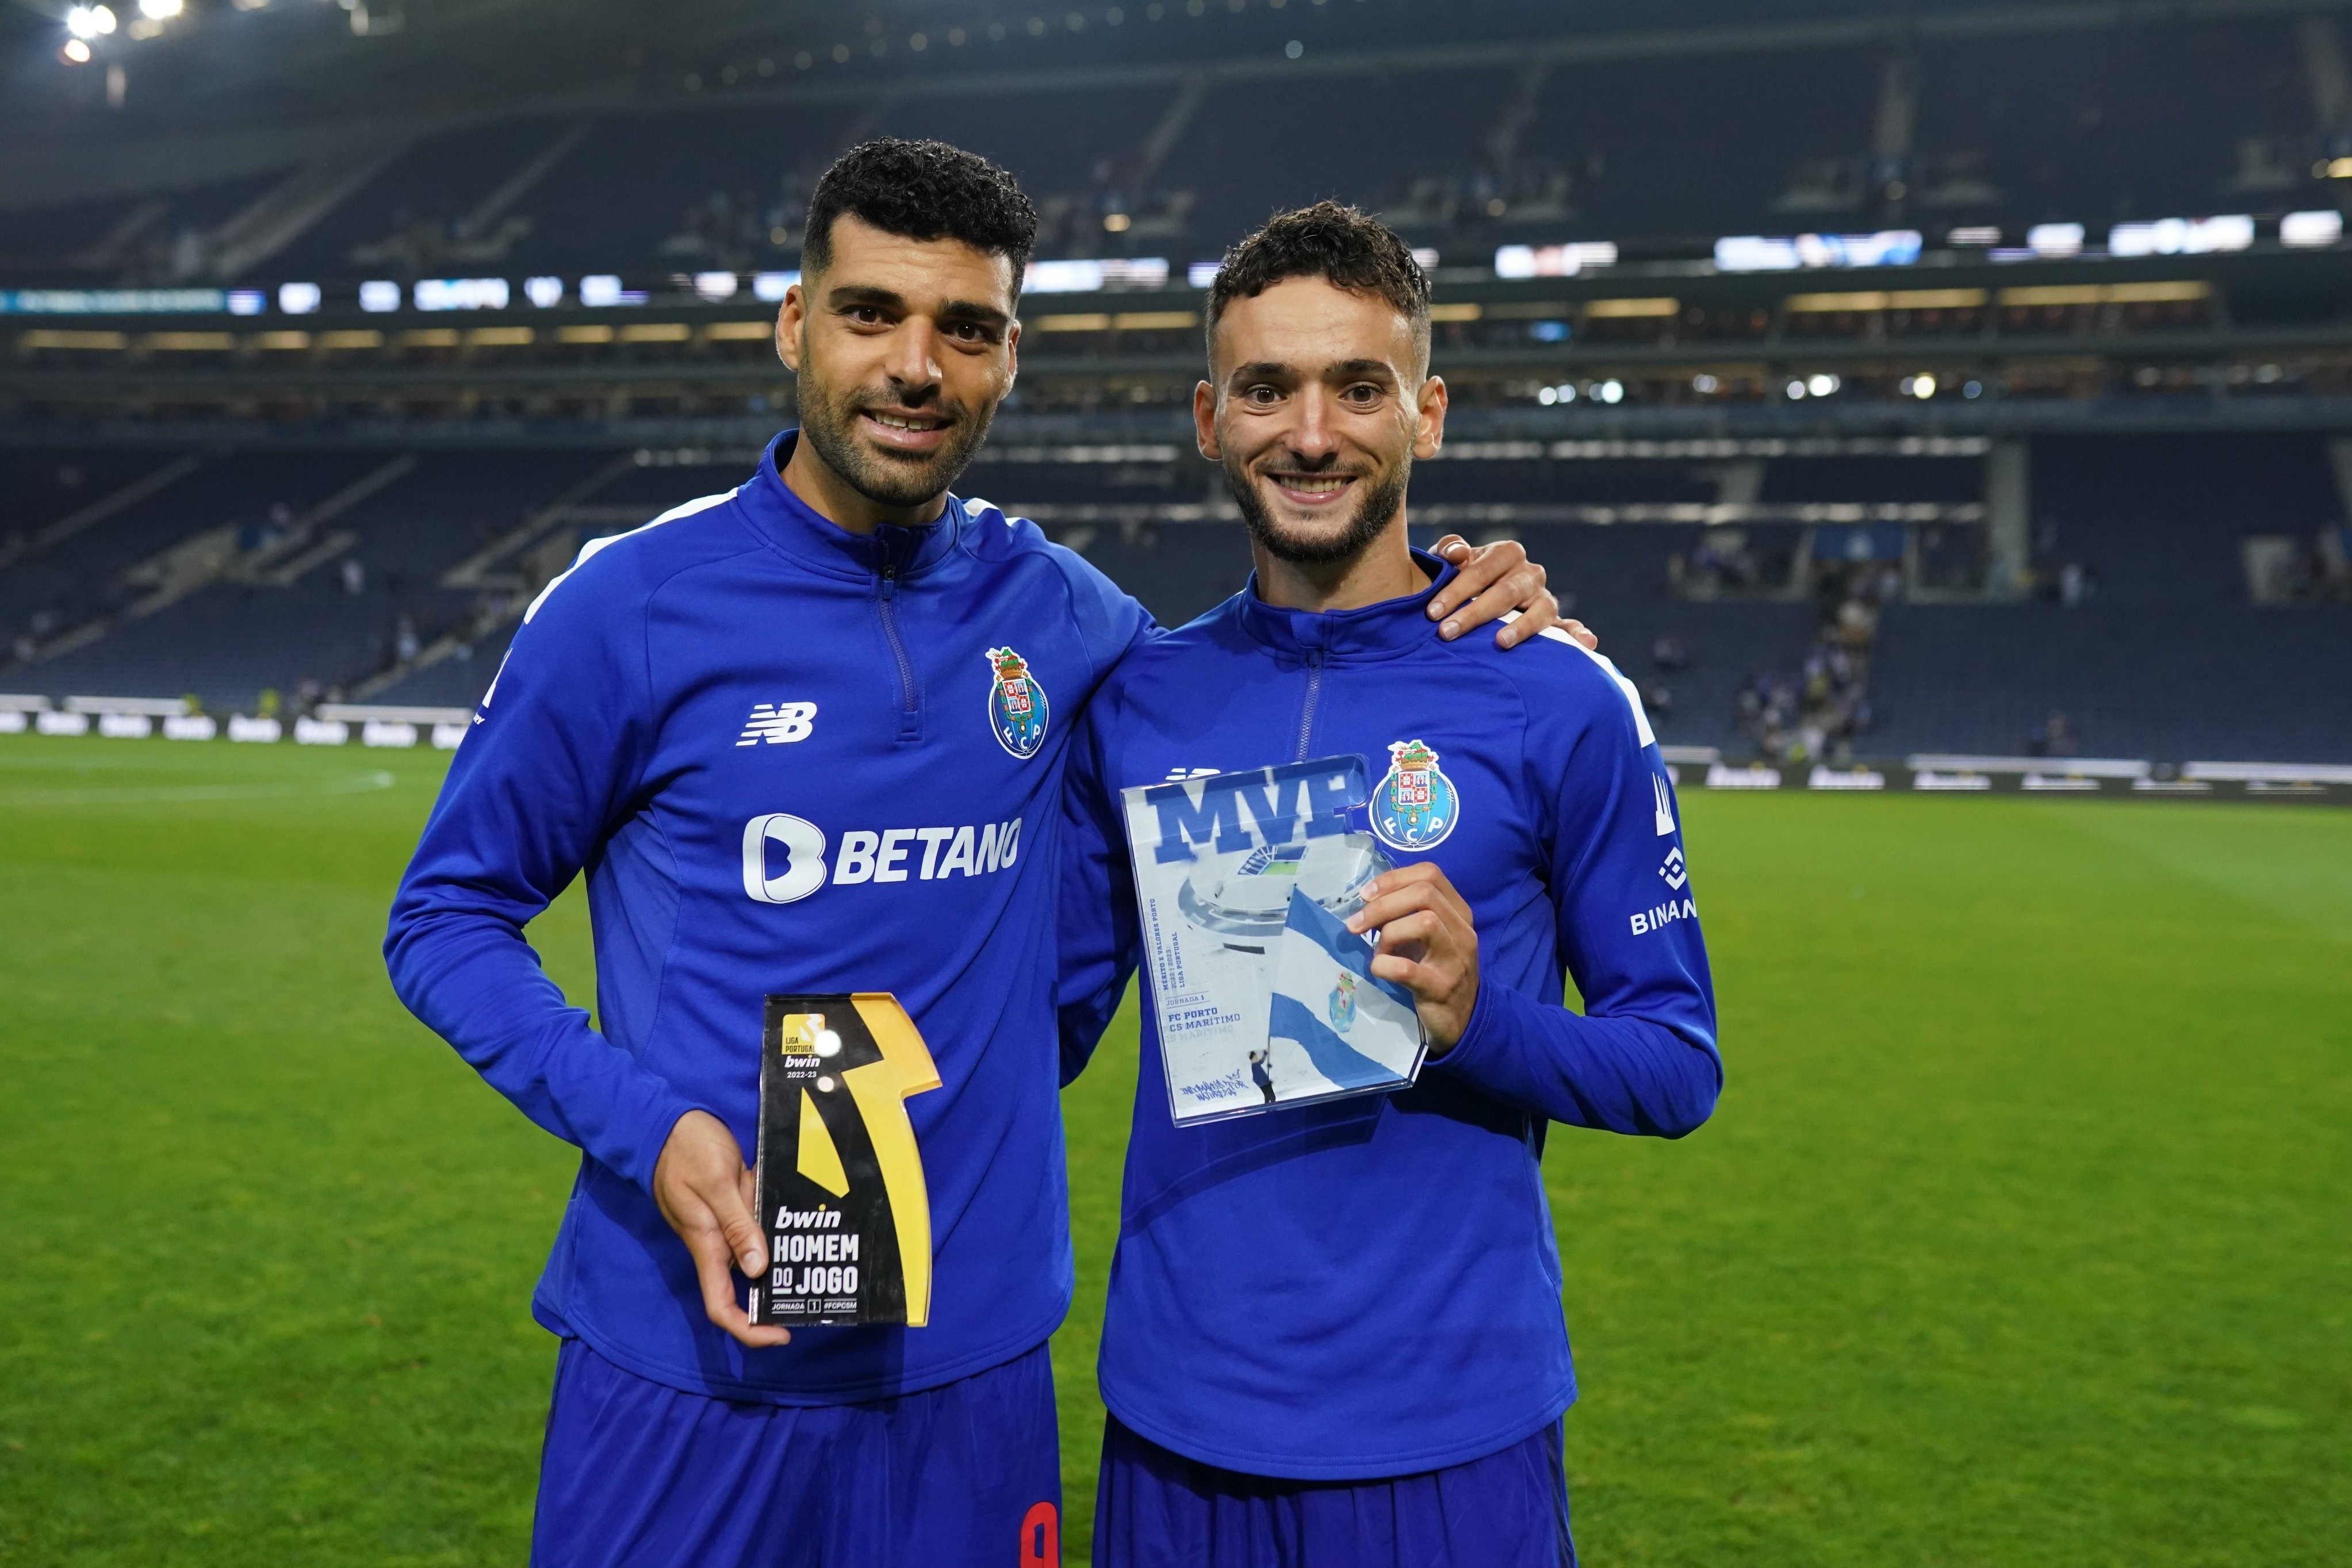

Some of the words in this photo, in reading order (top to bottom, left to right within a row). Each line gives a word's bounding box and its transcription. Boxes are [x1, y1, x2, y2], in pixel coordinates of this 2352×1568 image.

[1003, 724, 1041, 750] FCP
[1384, 816, 1443, 841] FCP
[832, 817, 1022, 885] BETANO
[1150, 899, 1158, 922] PORTO
[1154, 923, 1163, 955] VALORES
[1172, 932, 1182, 969] PORTUGAL
[1159, 963, 1169, 991] MÉRITO
[1166, 996, 1199, 1006] JORNADA
[1168, 1014, 1181, 1022] FC
[1184, 1007, 1218, 1019] PORTO
[1170, 1023, 1182, 1032] CS
[1186, 1013, 1240, 1029] MARÍTIMO
[784, 1055, 821, 1068] bwin
[786, 1045, 815, 1053] PORTUGAL
[787, 1071, 817, 1079] 2022-23
[775, 1203, 841, 1229] bwin
[773, 1234, 859, 1262] HOMEM
[773, 1267, 793, 1287] DO
[795, 1266, 858, 1294] JOGO
[772, 1301, 805, 1310] JORNADA
